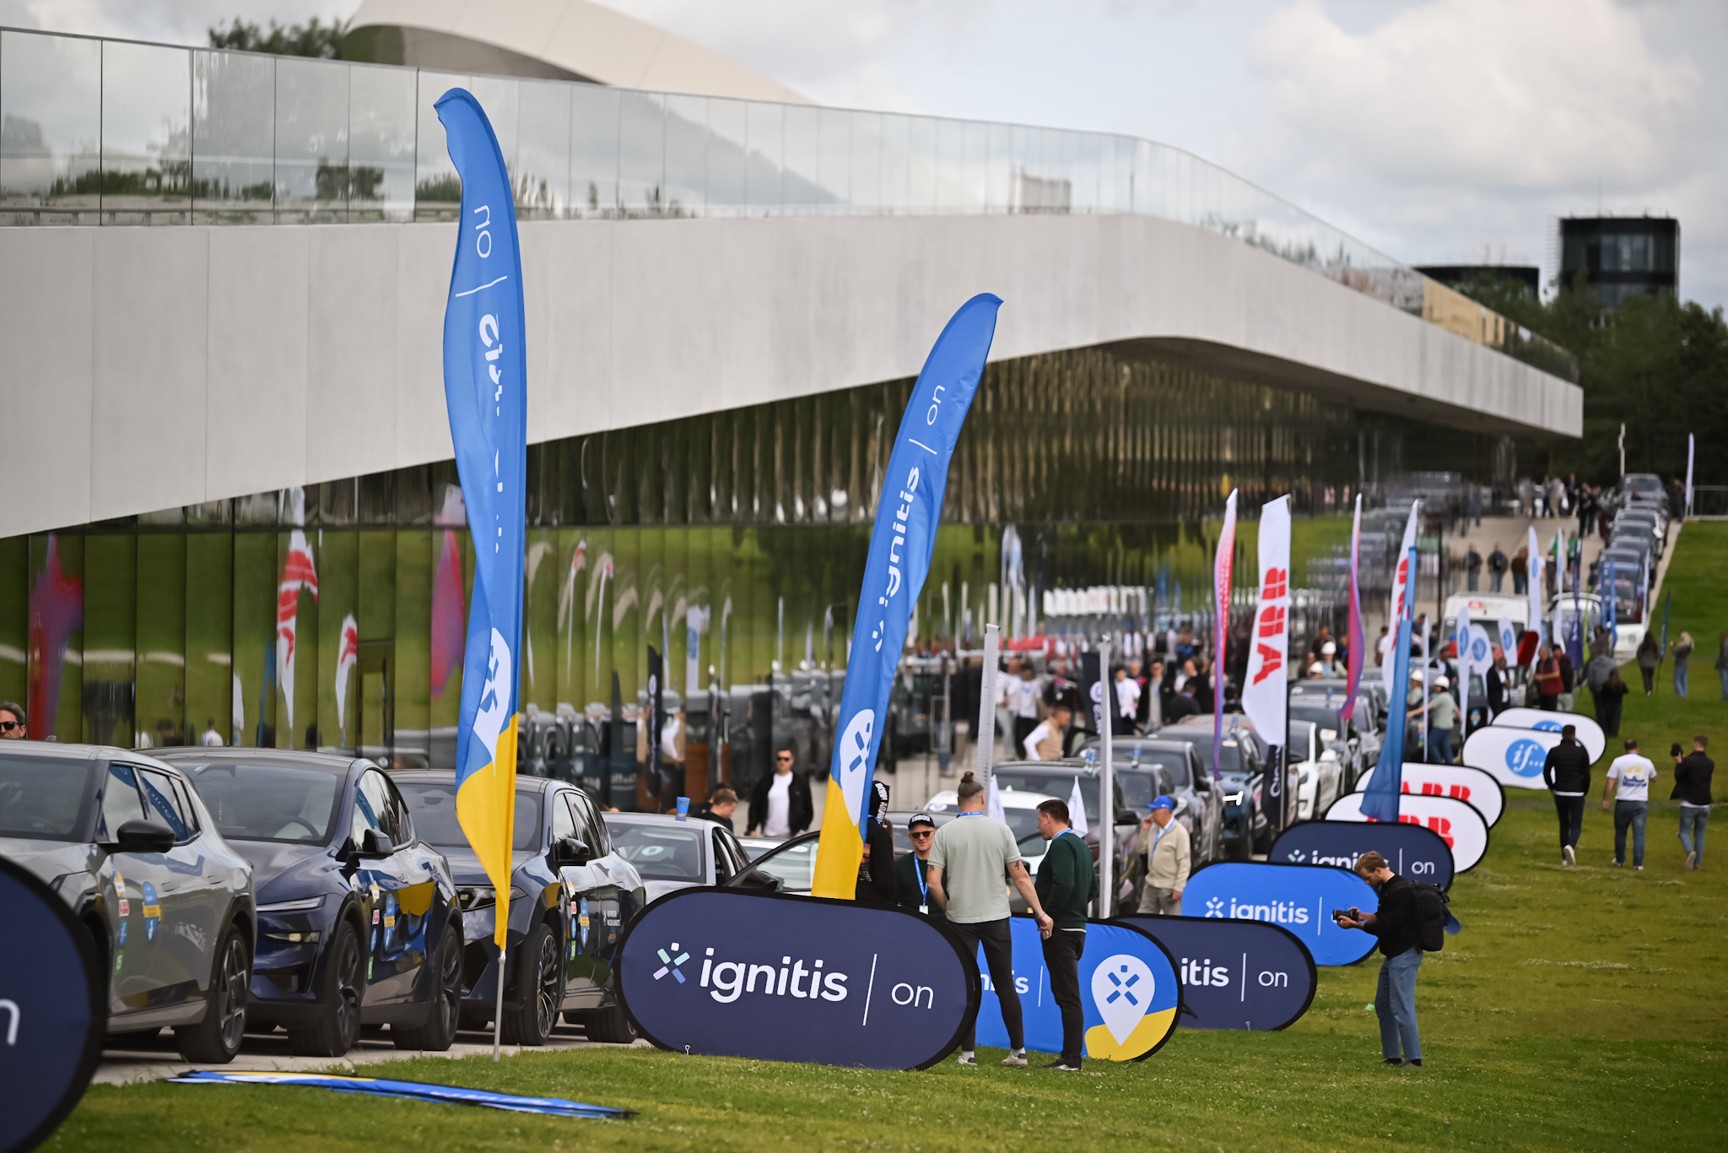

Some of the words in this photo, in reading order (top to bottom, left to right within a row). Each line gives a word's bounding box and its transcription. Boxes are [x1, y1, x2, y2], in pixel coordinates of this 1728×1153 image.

[926, 384, 946, 426] on
[1253, 566, 1287, 686] ABB
[1411, 861, 1435, 875] on
[700, 948, 848, 1004] ignitis
[891, 982, 934, 1010] on
[1181, 957, 1230, 987] itis
[1258, 970, 1288, 988] on
